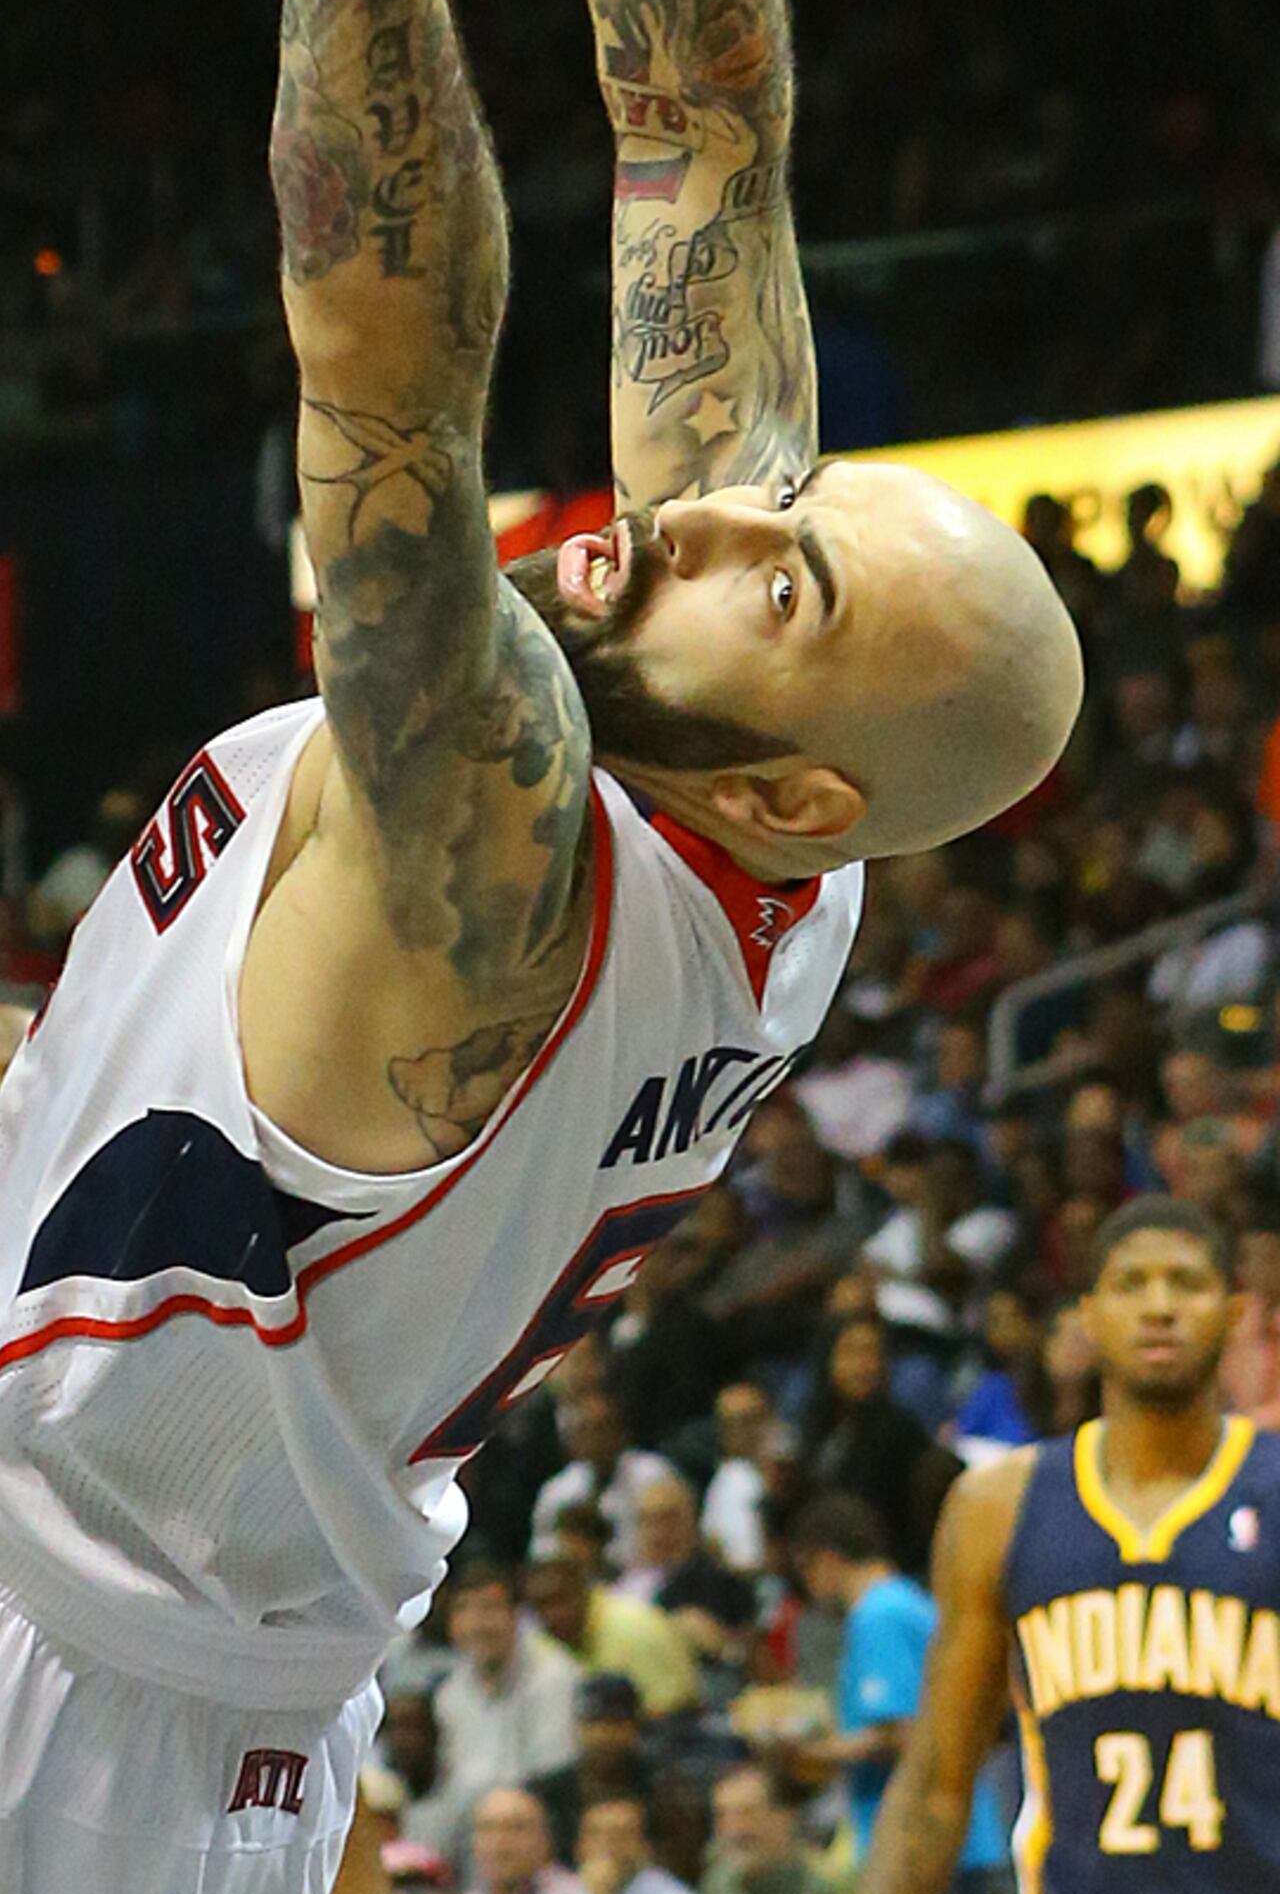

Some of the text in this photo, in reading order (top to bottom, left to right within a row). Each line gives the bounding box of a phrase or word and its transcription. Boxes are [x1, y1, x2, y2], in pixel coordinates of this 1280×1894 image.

[1017, 1582, 1280, 1720] INDIANA
[225, 1747, 309, 1815] ATL
[1095, 1728, 1226, 1854] 24
